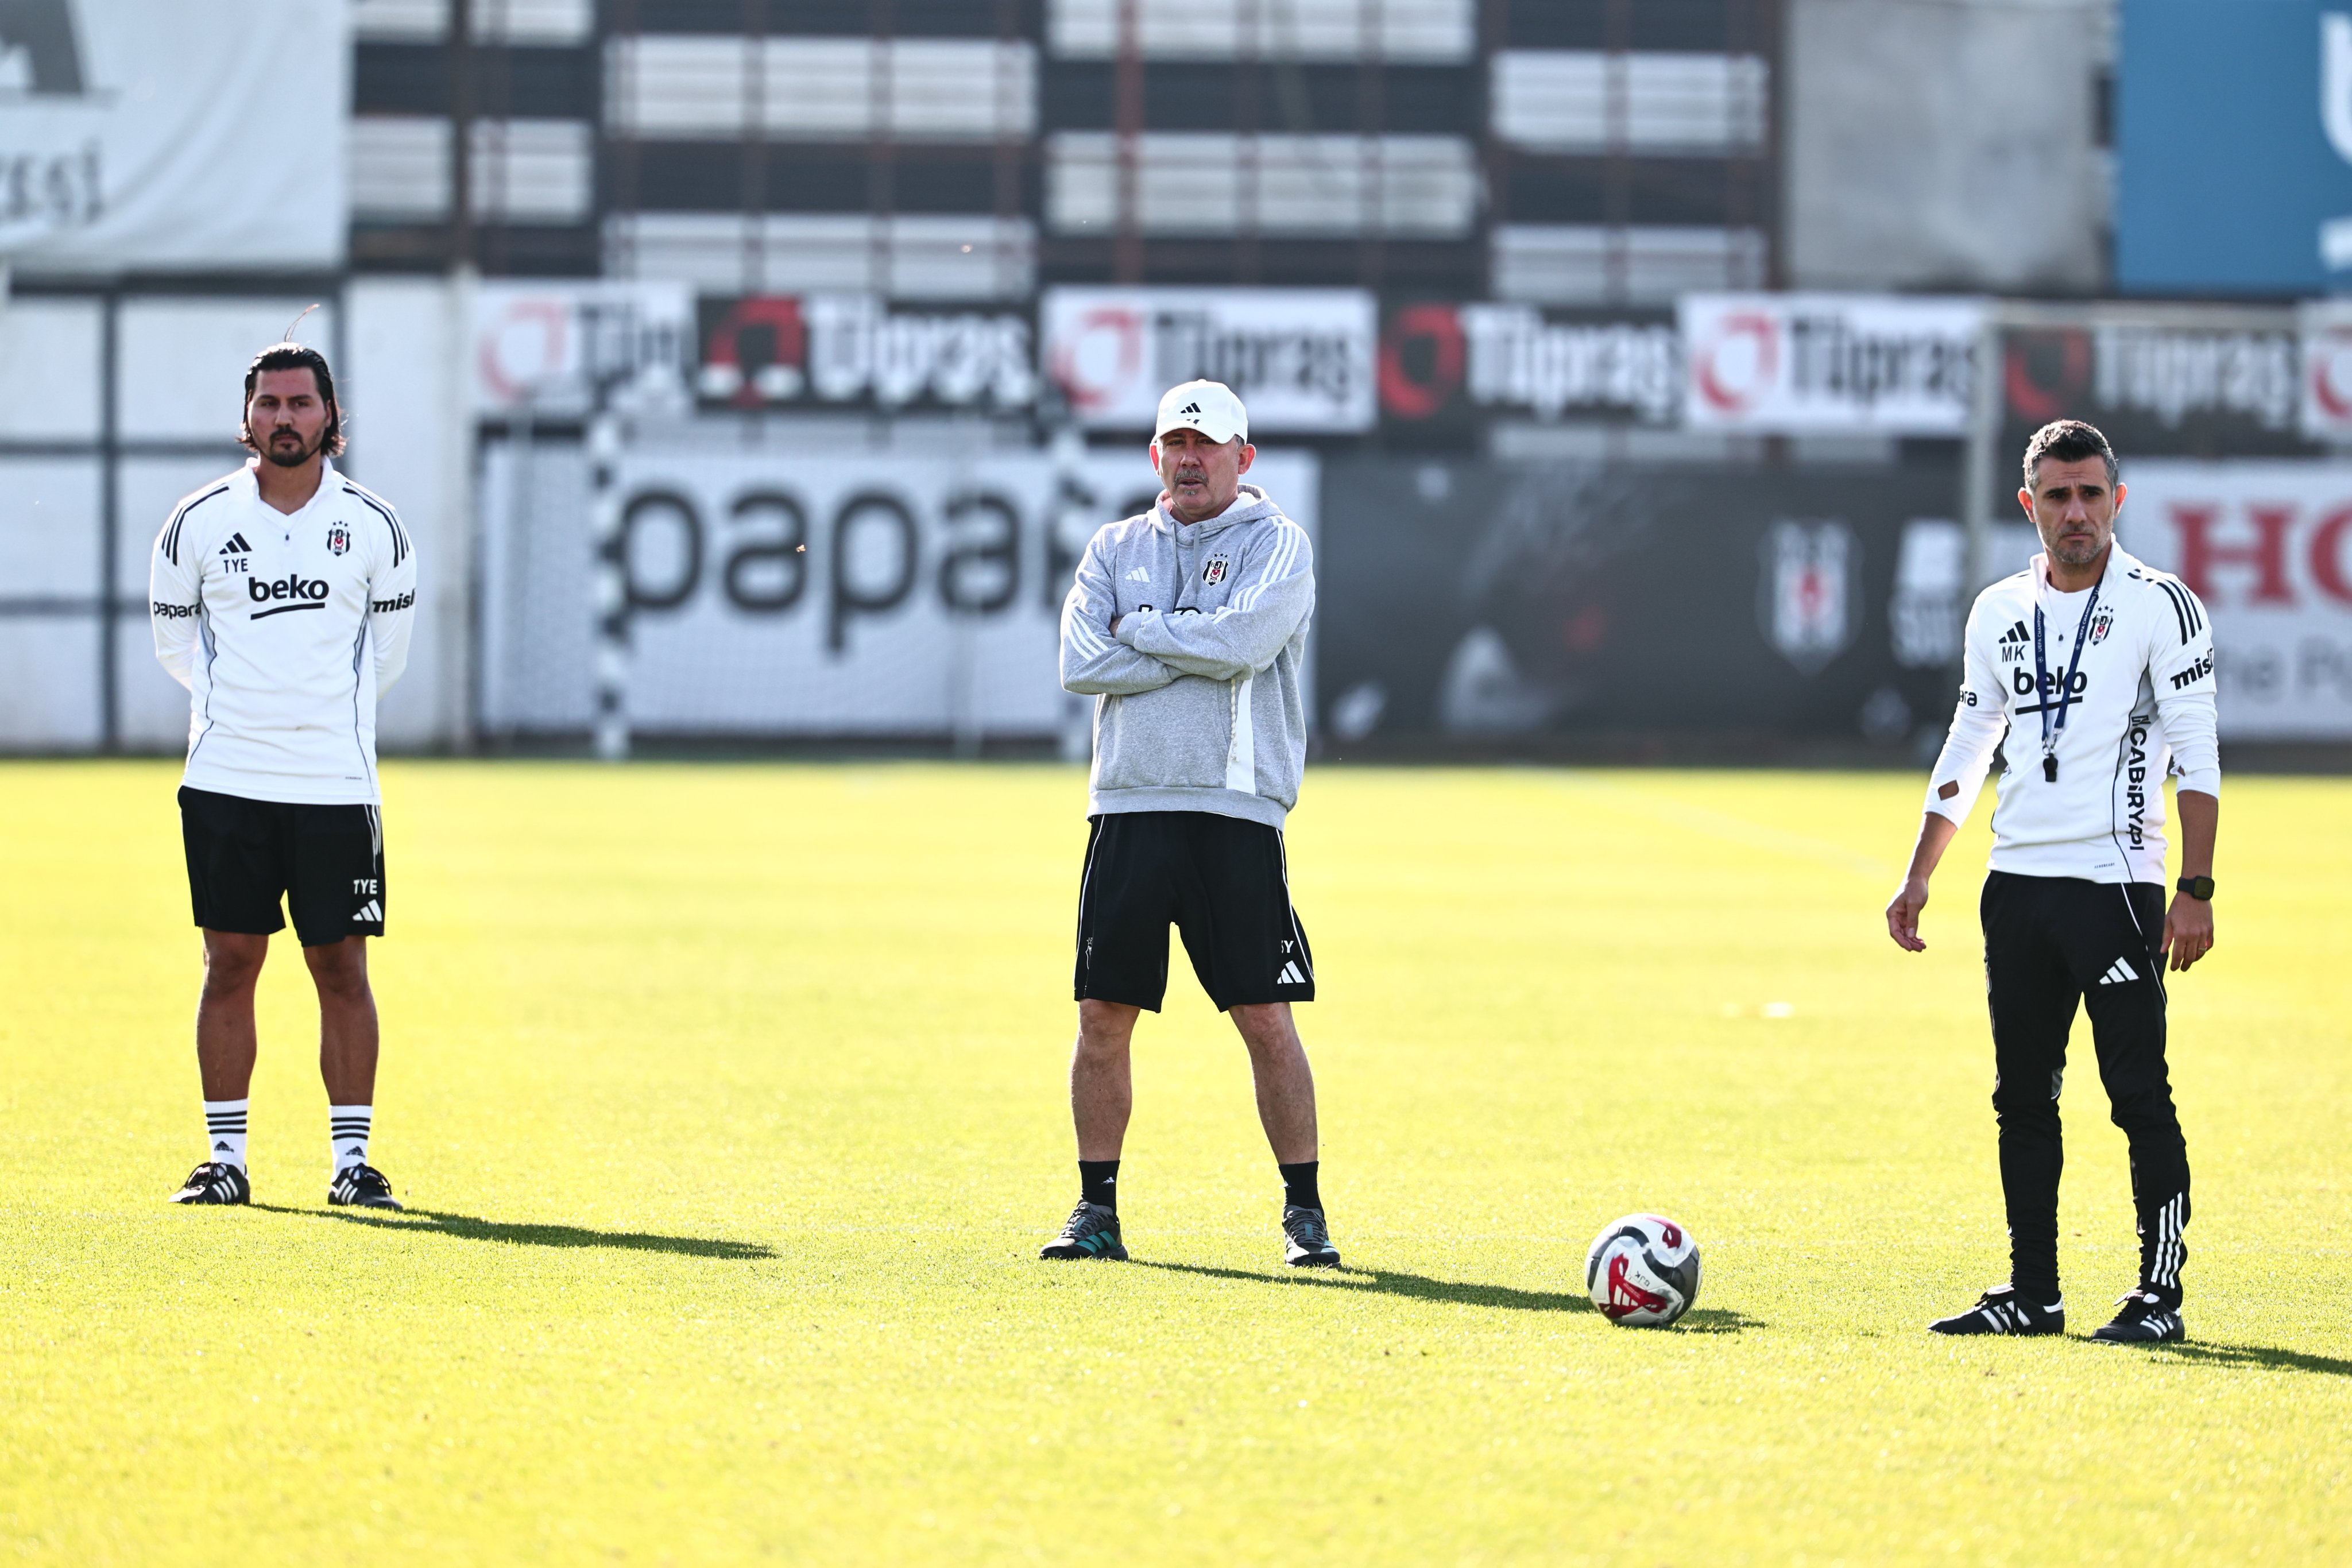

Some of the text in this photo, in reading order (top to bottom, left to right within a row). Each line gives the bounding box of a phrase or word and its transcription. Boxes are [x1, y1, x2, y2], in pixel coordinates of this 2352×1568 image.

[223, 558, 248, 573] TYE
[249, 574, 329, 602] beko
[2083, 595, 2096, 624] CHAMPIONS
[2002, 645, 2026, 663] MK
[354, 878, 377, 895] TYE
